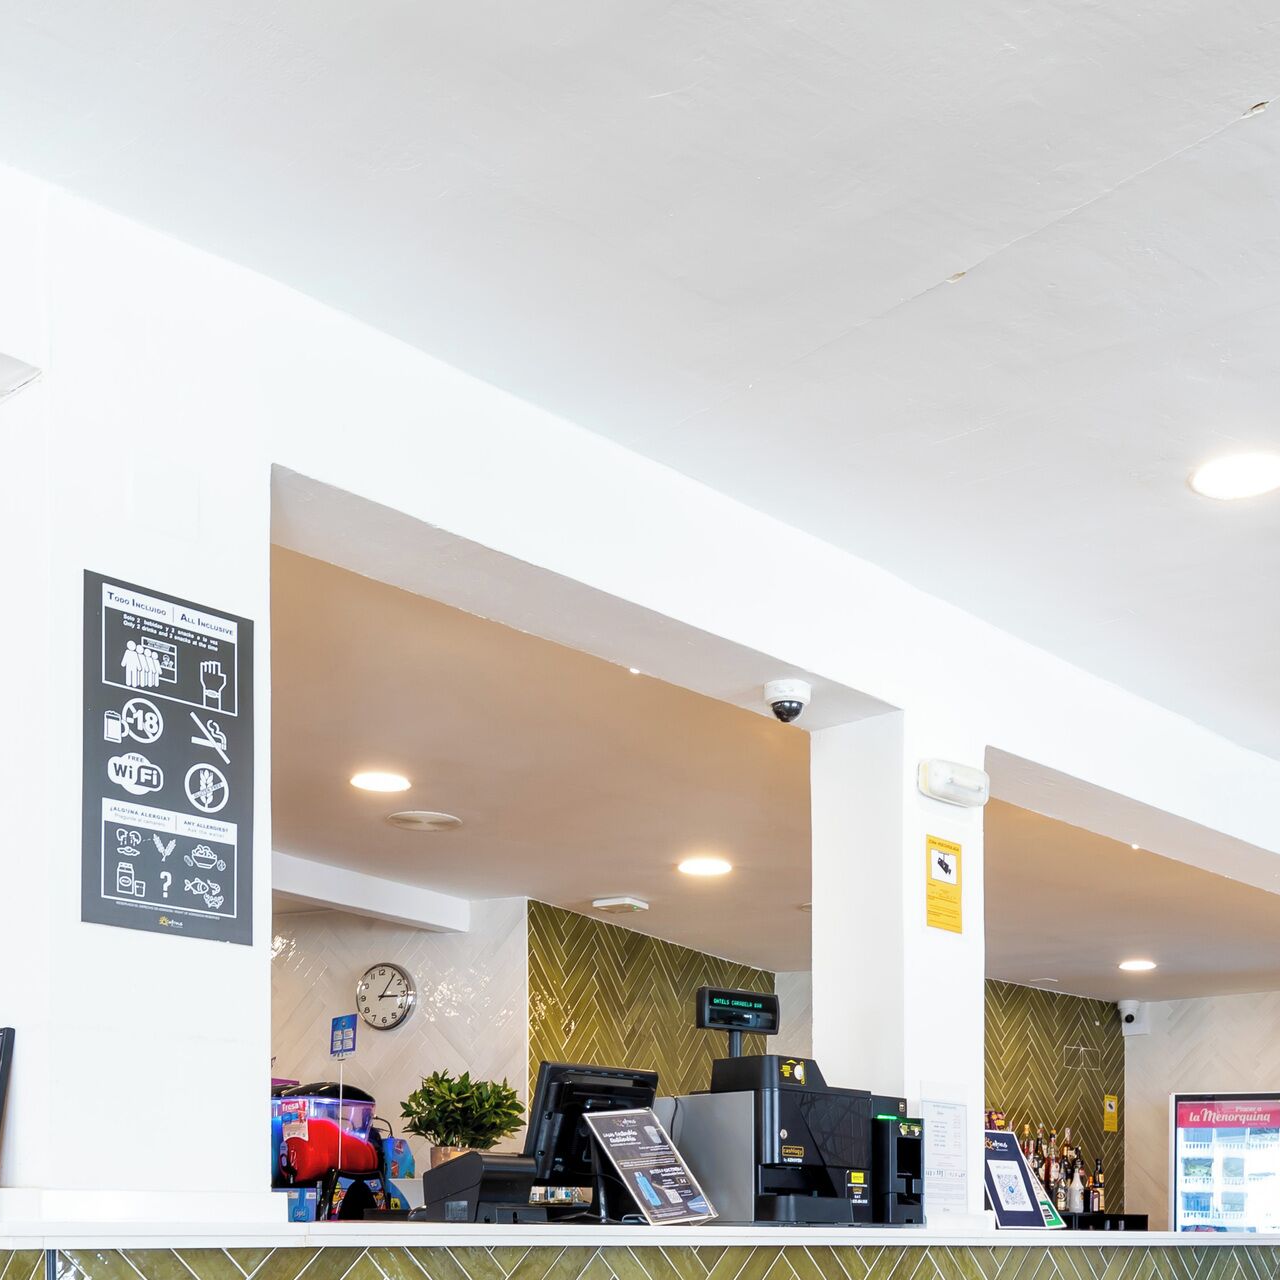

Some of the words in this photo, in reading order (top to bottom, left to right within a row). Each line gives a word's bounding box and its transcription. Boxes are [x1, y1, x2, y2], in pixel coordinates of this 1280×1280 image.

[127, 755, 144, 763] FREE
[378, 968, 386, 976] 12
[400, 990, 407, 998] 3
[364, 1006, 370, 1014] 8
[371, 1014, 377, 1022] 7
[381, 1016, 388, 1024] 6
[1189, 1111, 1200, 1122] la
[1200, 1107, 1271, 1124] Menorquina
